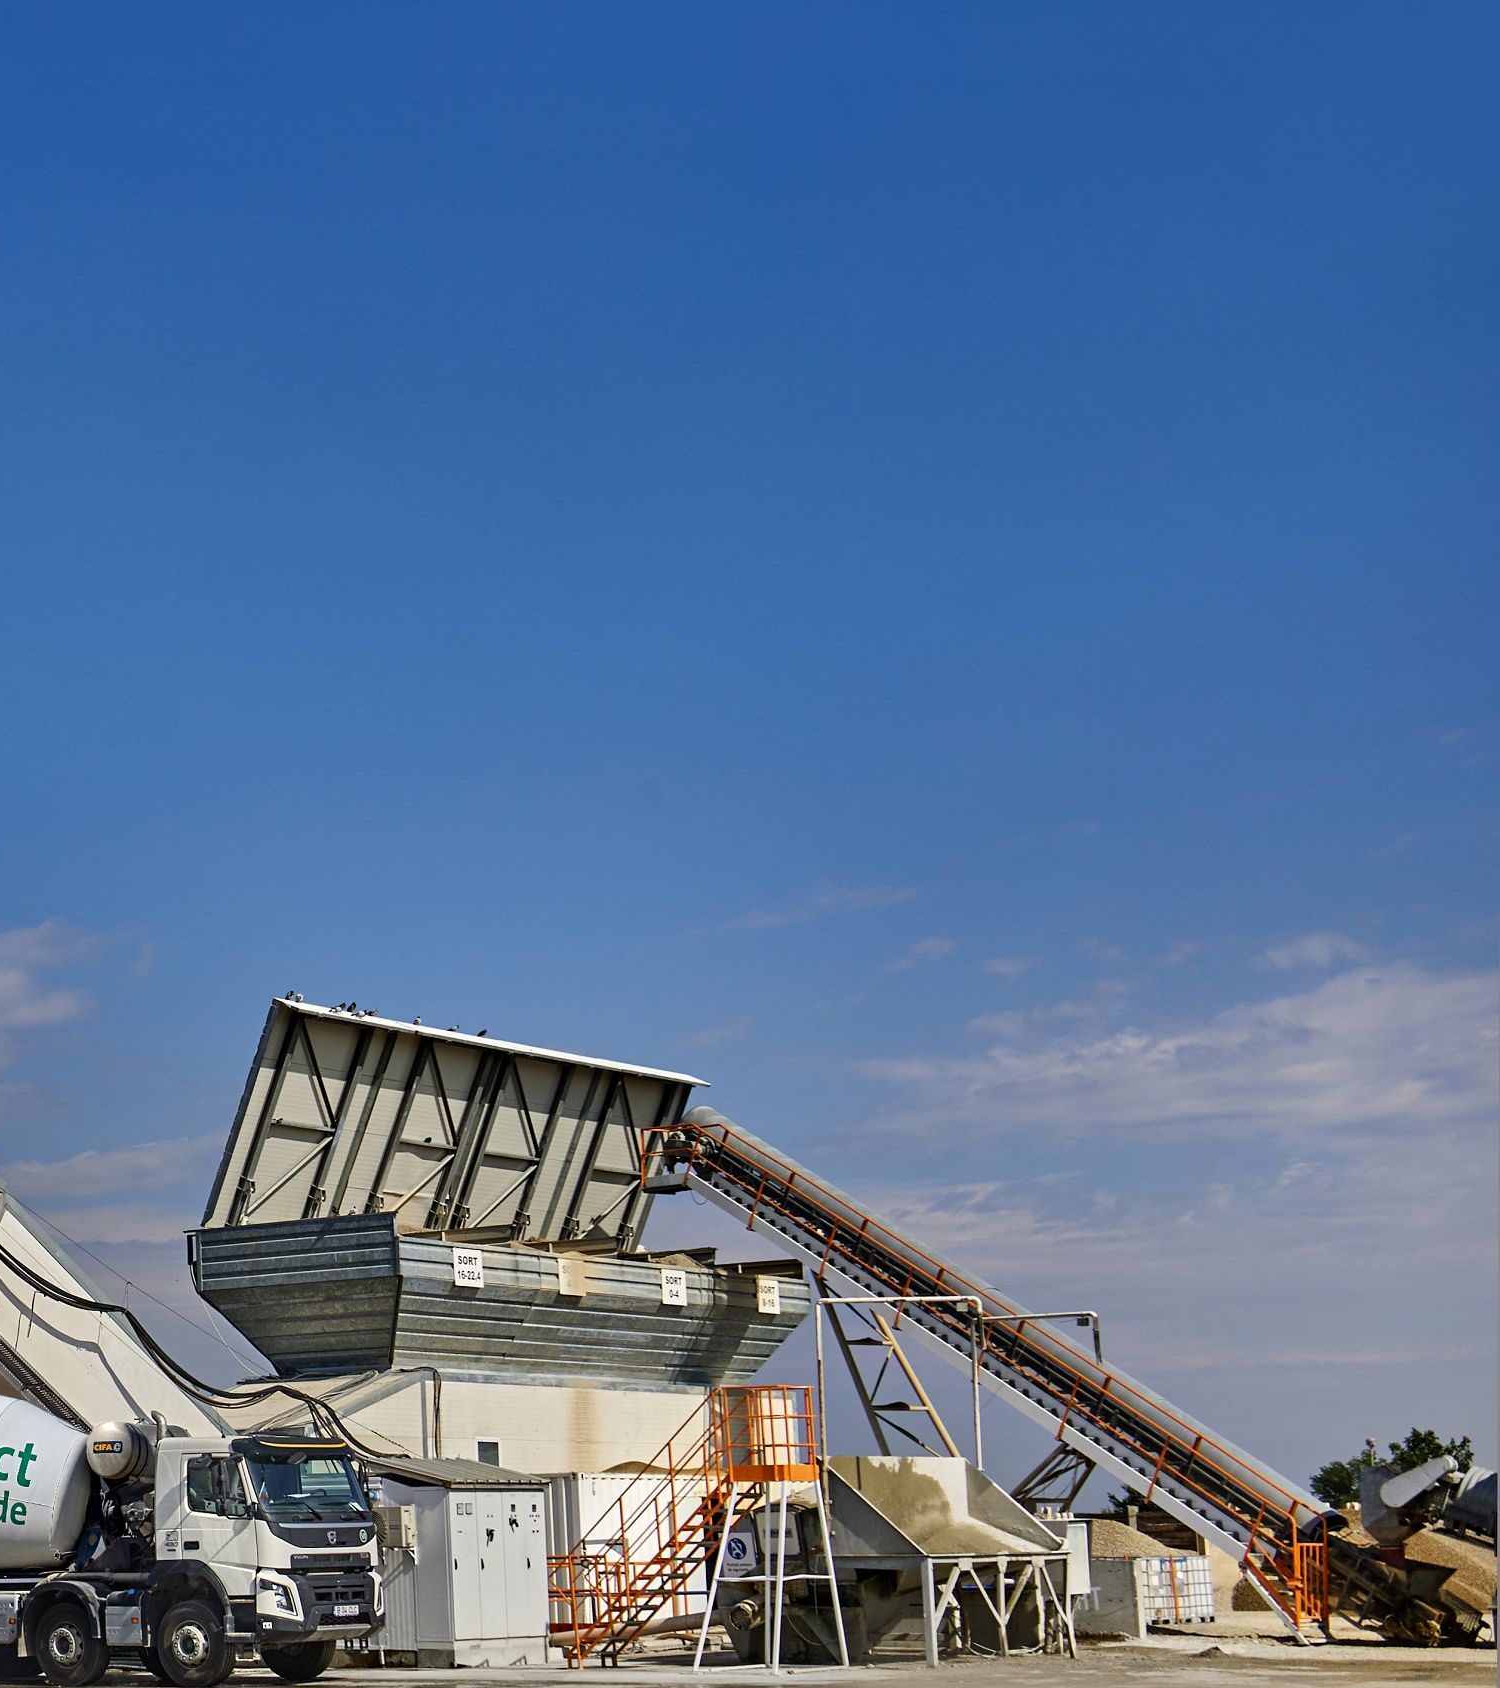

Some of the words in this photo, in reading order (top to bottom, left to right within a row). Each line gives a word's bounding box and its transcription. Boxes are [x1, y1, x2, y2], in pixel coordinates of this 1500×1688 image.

[457, 1255, 478, 1266] SORT
[665, 1275, 682, 1286] SORT
[759, 1285, 775, 1295] SORT
[93, 1443, 113, 1451] CIFA
